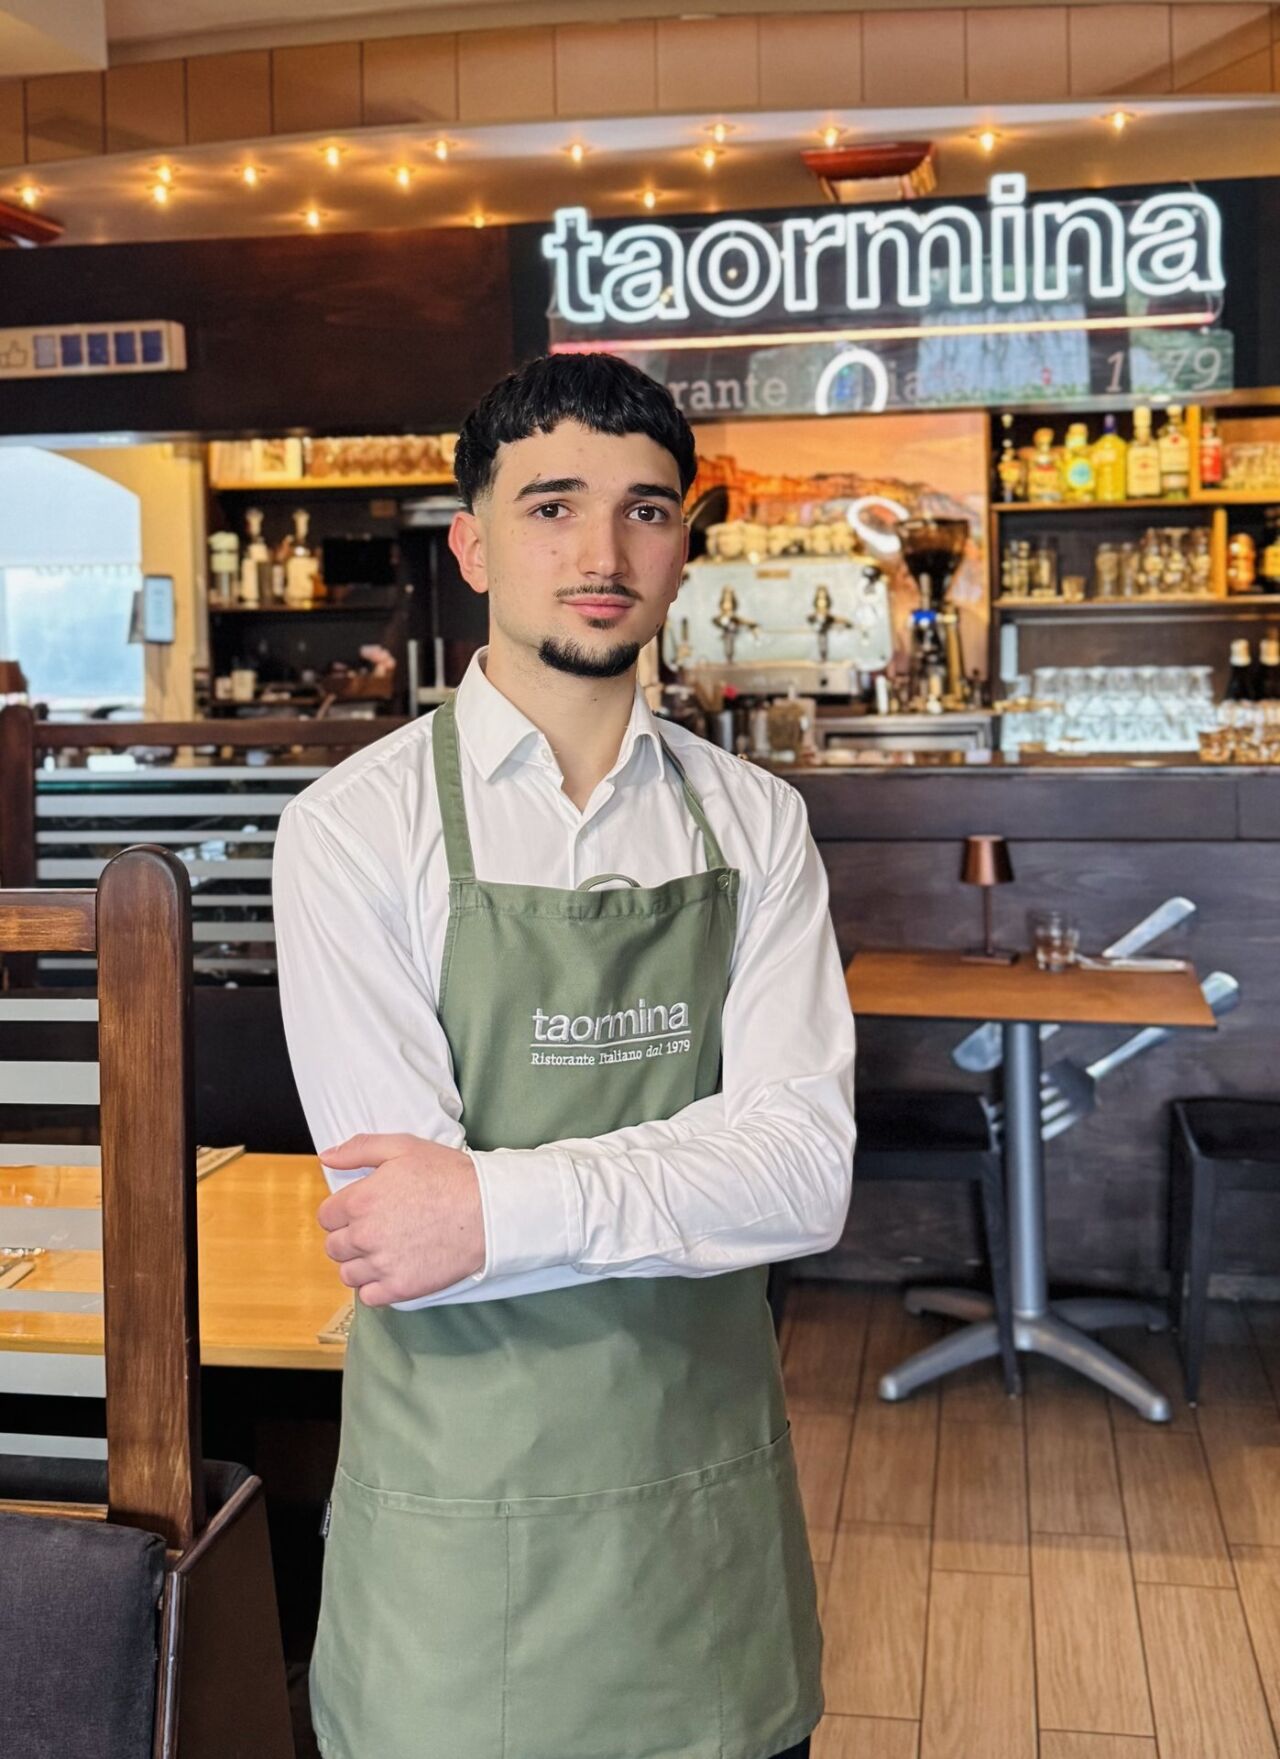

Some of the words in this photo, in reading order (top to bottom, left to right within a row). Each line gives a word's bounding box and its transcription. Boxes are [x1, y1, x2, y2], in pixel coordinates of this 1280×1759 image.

[541, 173, 1226, 323] taormina
[667, 371, 788, 411] rante
[1107, 347, 1220, 392] 179
[532, 998, 689, 1042] taormina
[531, 1052, 595, 1066] Ristorante
[600, 1048, 642, 1065] Italiano
[645, 1043, 663, 1058] dal
[666, 1039, 691, 1055] 1979
